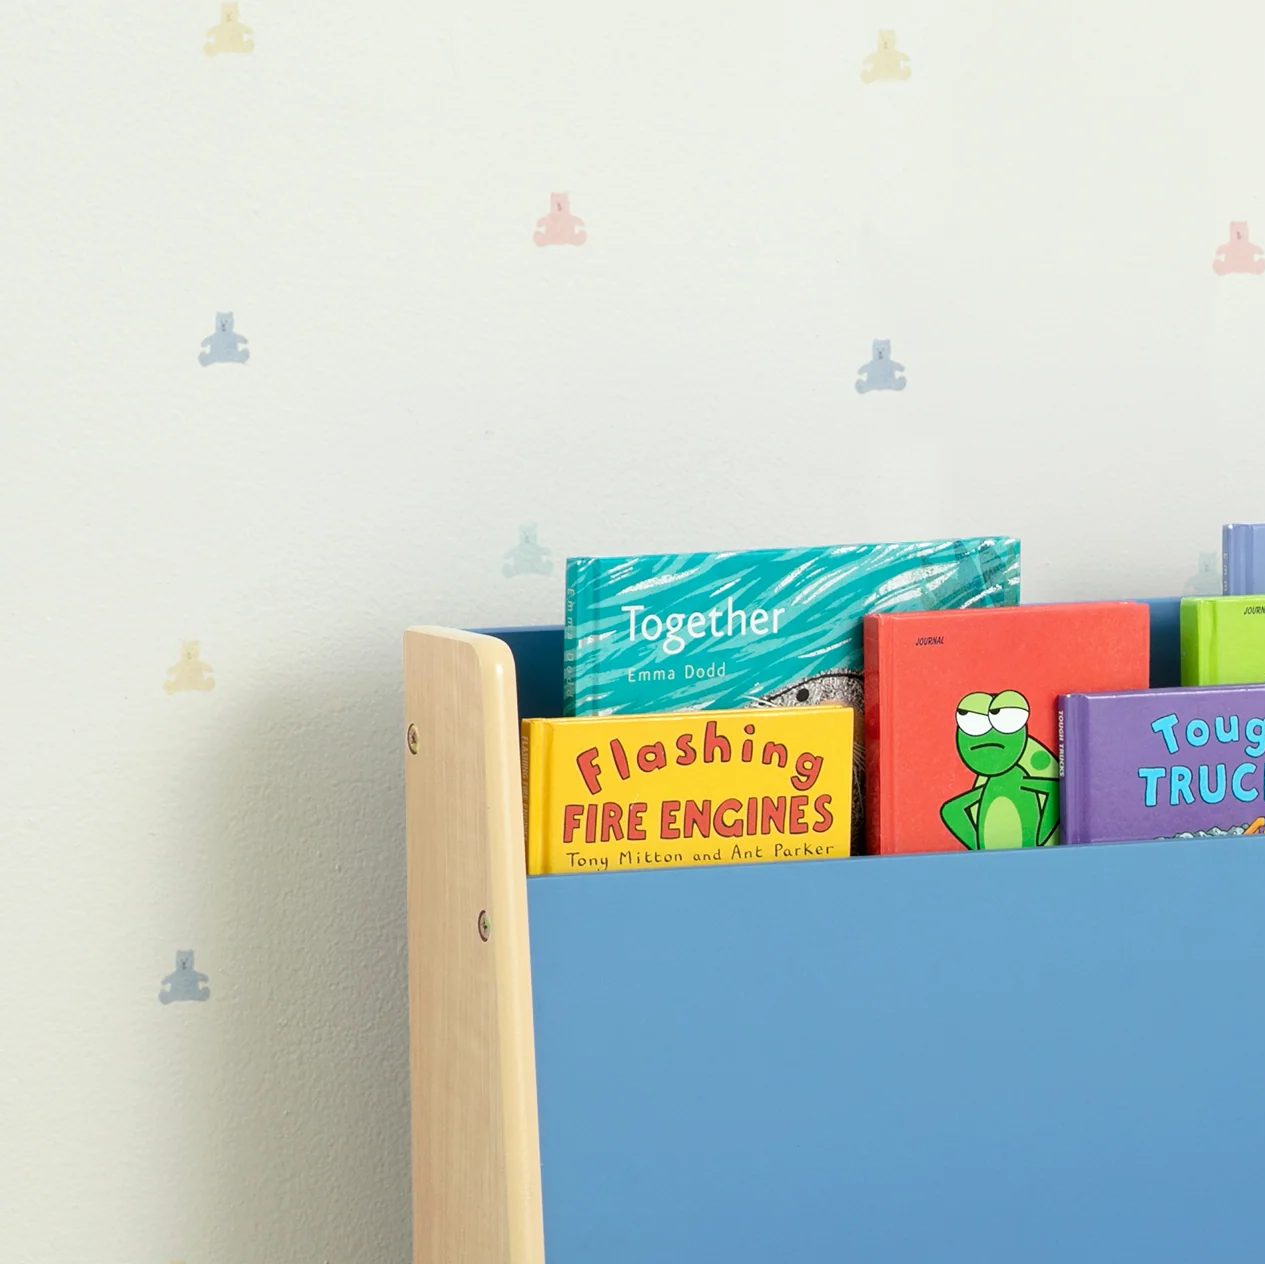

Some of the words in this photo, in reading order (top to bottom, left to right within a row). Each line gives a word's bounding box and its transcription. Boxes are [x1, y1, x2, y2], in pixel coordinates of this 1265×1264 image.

[621, 597, 786, 657] Together
[915, 636, 944, 646] JOURNAL
[627, 665, 675, 682] Emma
[684, 662, 727, 680] Dodd
[576, 721, 824, 794] Flashing
[563, 803, 646, 845] FIRE
[660, 793, 834, 840] ENGINES
[566, 850, 610, 871] Tony
[618, 848, 684, 866] Mitton
[693, 846, 726, 863] and
[731, 844, 764, 860] Ant
[773, 842, 834, 858] Parker
